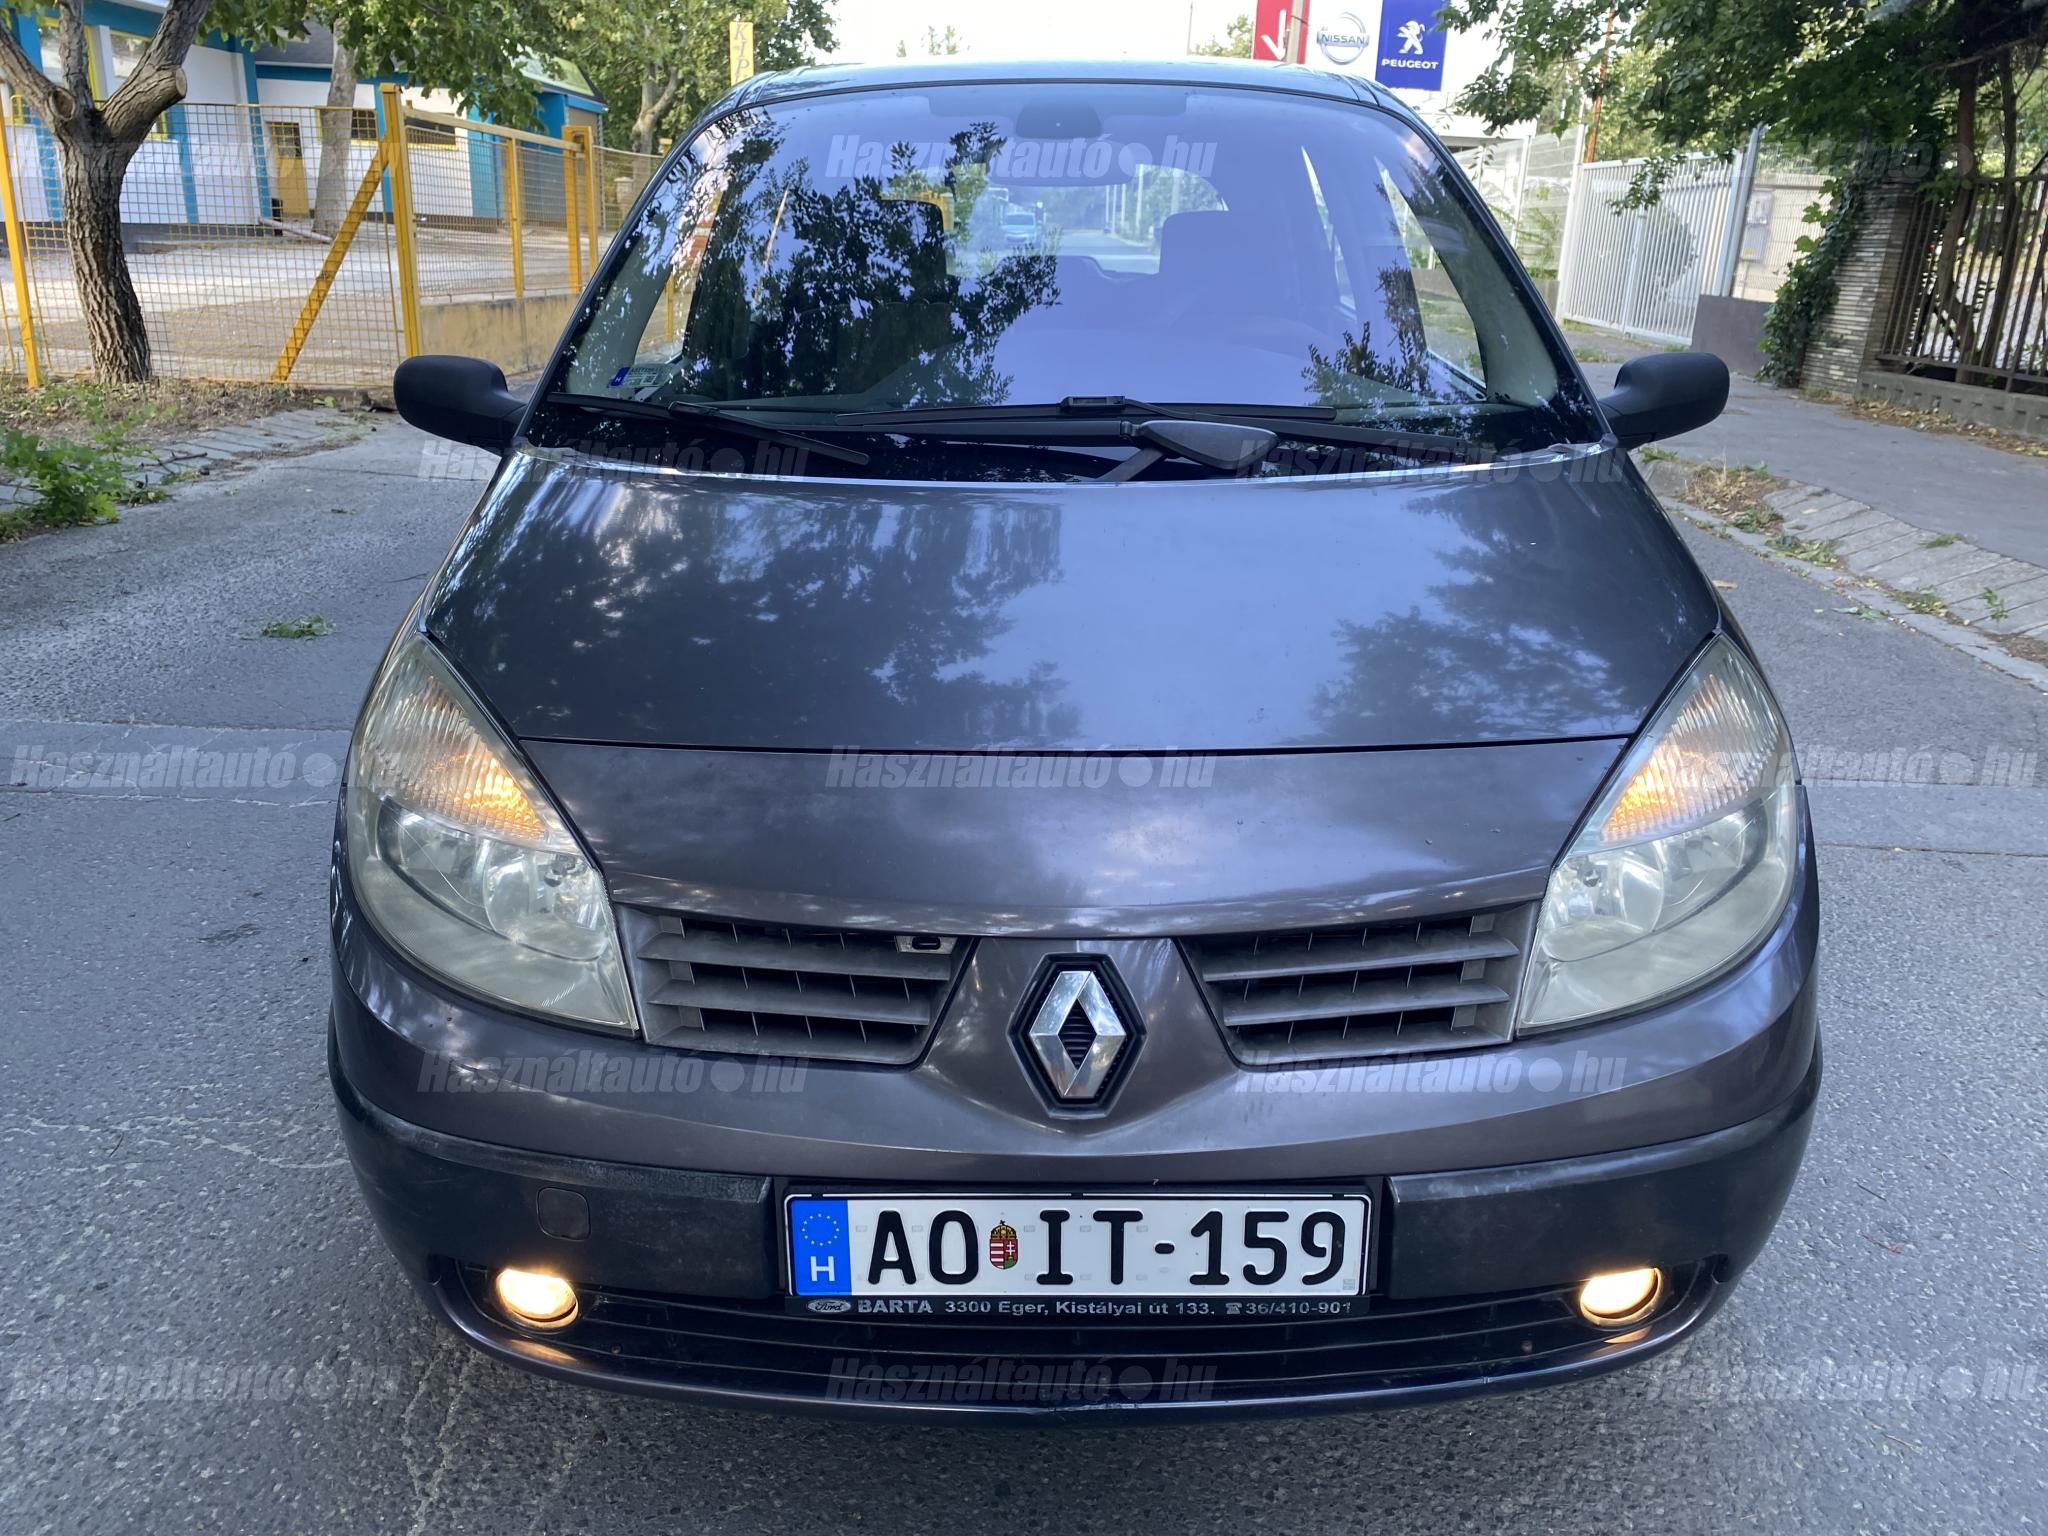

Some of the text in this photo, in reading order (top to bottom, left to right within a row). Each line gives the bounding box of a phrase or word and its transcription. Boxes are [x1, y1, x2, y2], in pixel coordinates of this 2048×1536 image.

[1322, 33, 1365, 44] NISSAN
[1381, 59, 1439, 69] PEUGEOT
[867, 1209, 1346, 1286] AO IT-159
[810, 1256, 836, 1282] H
[858, 1300, 933, 1313] BARTA
[945, 1300, 991, 1313] 3300
[998, 1301, 1049, 1316] Eger,
[1056, 1301, 1141, 1316] Kistályai
[1149, 1302, 1169, 1314] út
[1176, 1302, 1215, 1315] 133.
